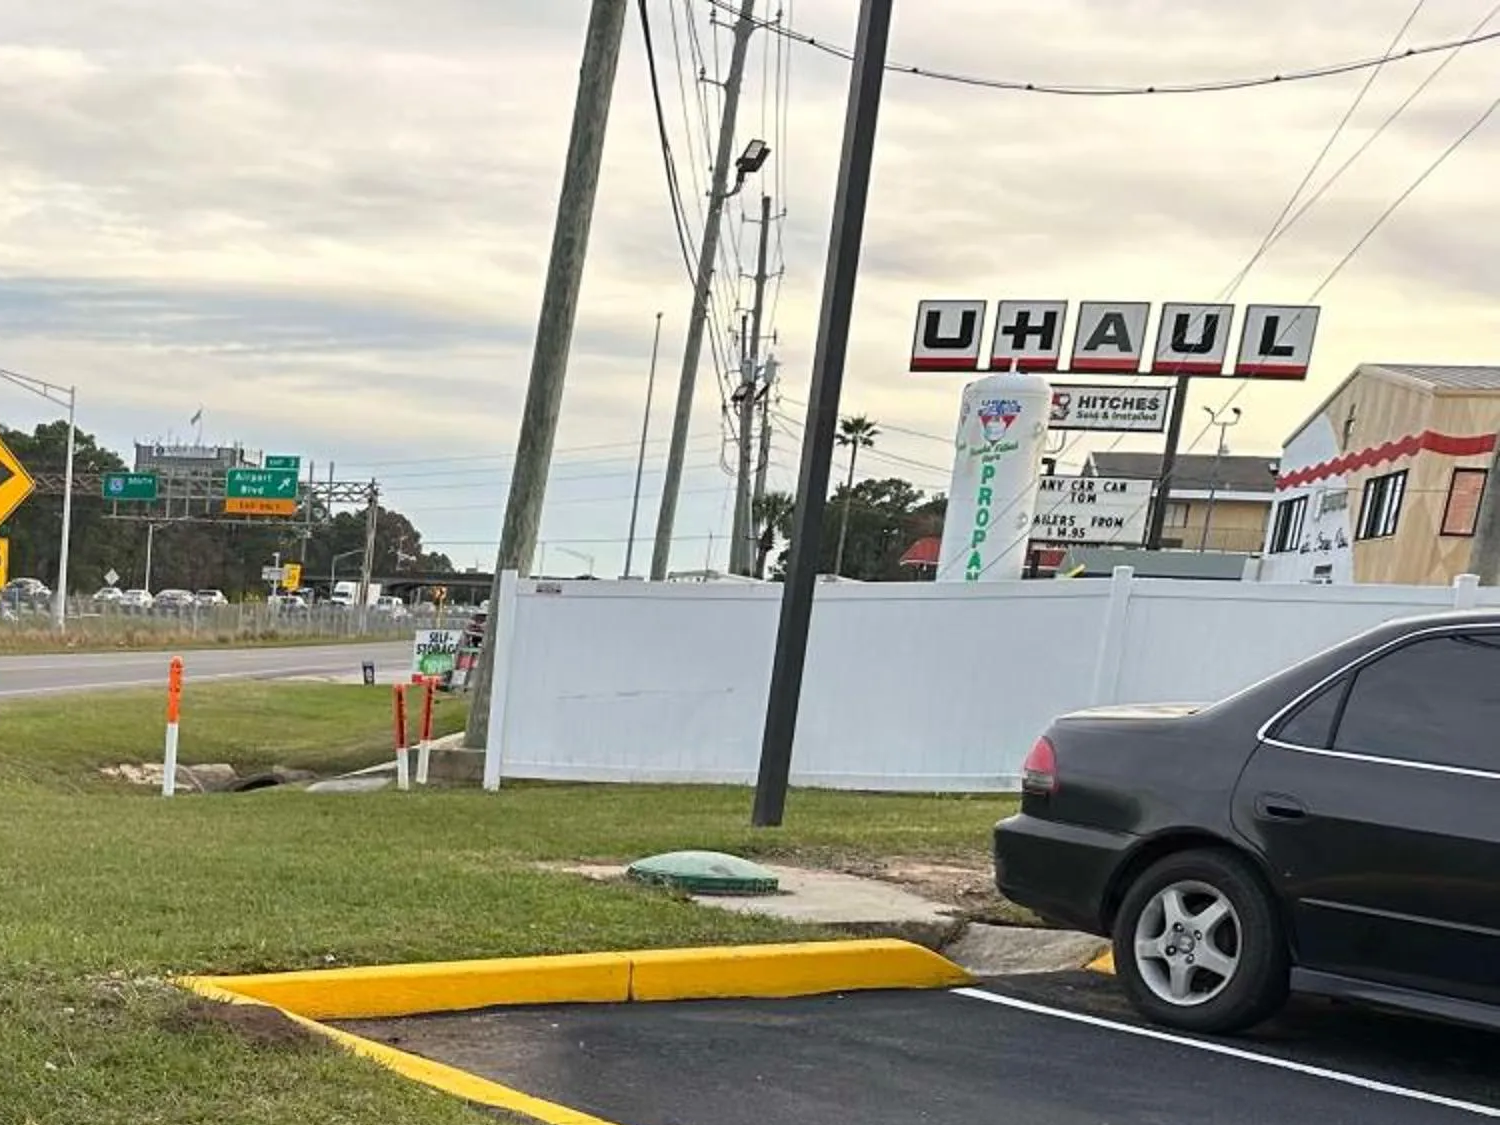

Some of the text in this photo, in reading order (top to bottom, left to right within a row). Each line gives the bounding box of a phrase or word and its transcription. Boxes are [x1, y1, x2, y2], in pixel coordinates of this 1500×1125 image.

[1077, 395, 1160, 411] HITCHES
[1111, 411, 1157, 421] Installed
[235, 472, 273, 482] Airport
[241, 485, 264, 495] Blvd
[1039, 480, 1065, 491] ANY
[1071, 480, 1096, 492] CAR
[1091, 516, 1125, 528] FROM
